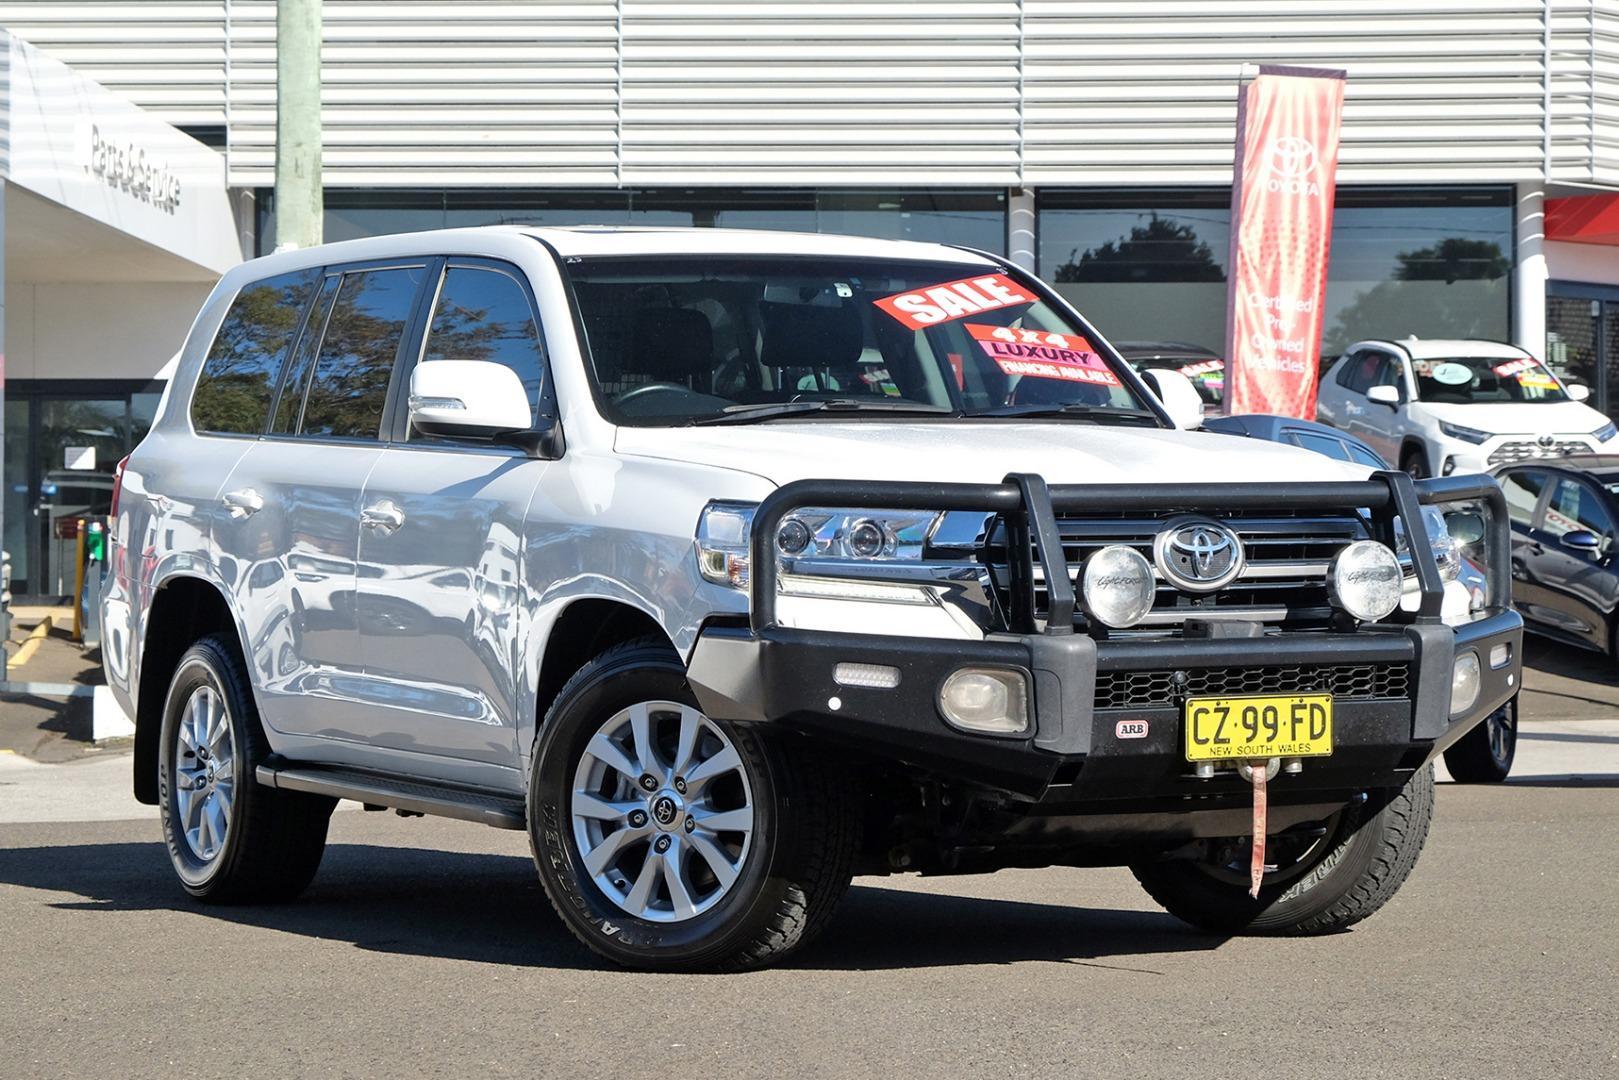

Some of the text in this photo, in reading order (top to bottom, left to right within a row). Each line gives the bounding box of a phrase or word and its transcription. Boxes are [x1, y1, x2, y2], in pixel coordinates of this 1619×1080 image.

[893, 277, 1026, 323] SALE
[1248, 293, 1312, 312] Certed
[991, 343, 1090, 364] LUXURY
[1121, 725, 1144, 734] ARB
[1210, 743, 1311, 756] NEW SOUTH WALES
